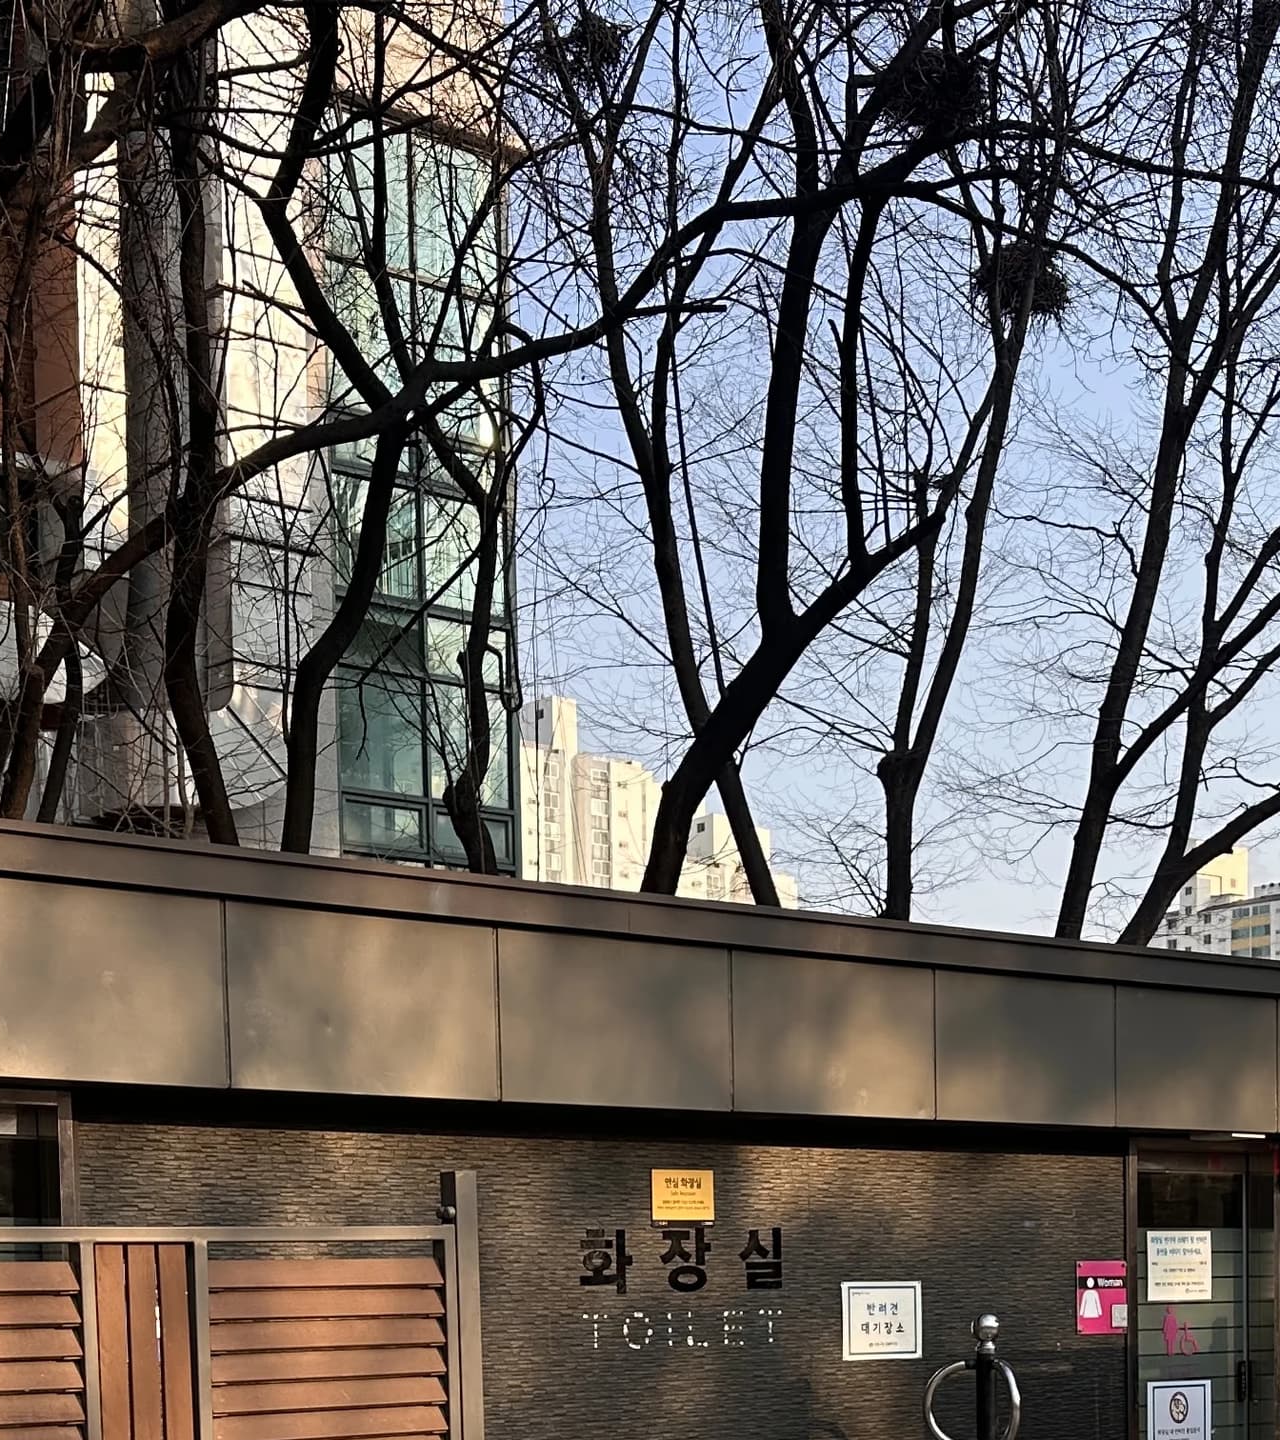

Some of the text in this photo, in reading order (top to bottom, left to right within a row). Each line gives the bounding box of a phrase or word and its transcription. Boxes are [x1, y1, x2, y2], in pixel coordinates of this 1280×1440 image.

[580, 1227, 783, 1294] 화장실
[866, 1302, 899, 1316] 반려견
[582, 1309, 782, 1350] TOILET
[861, 1321, 905, 1335] 대기장소
